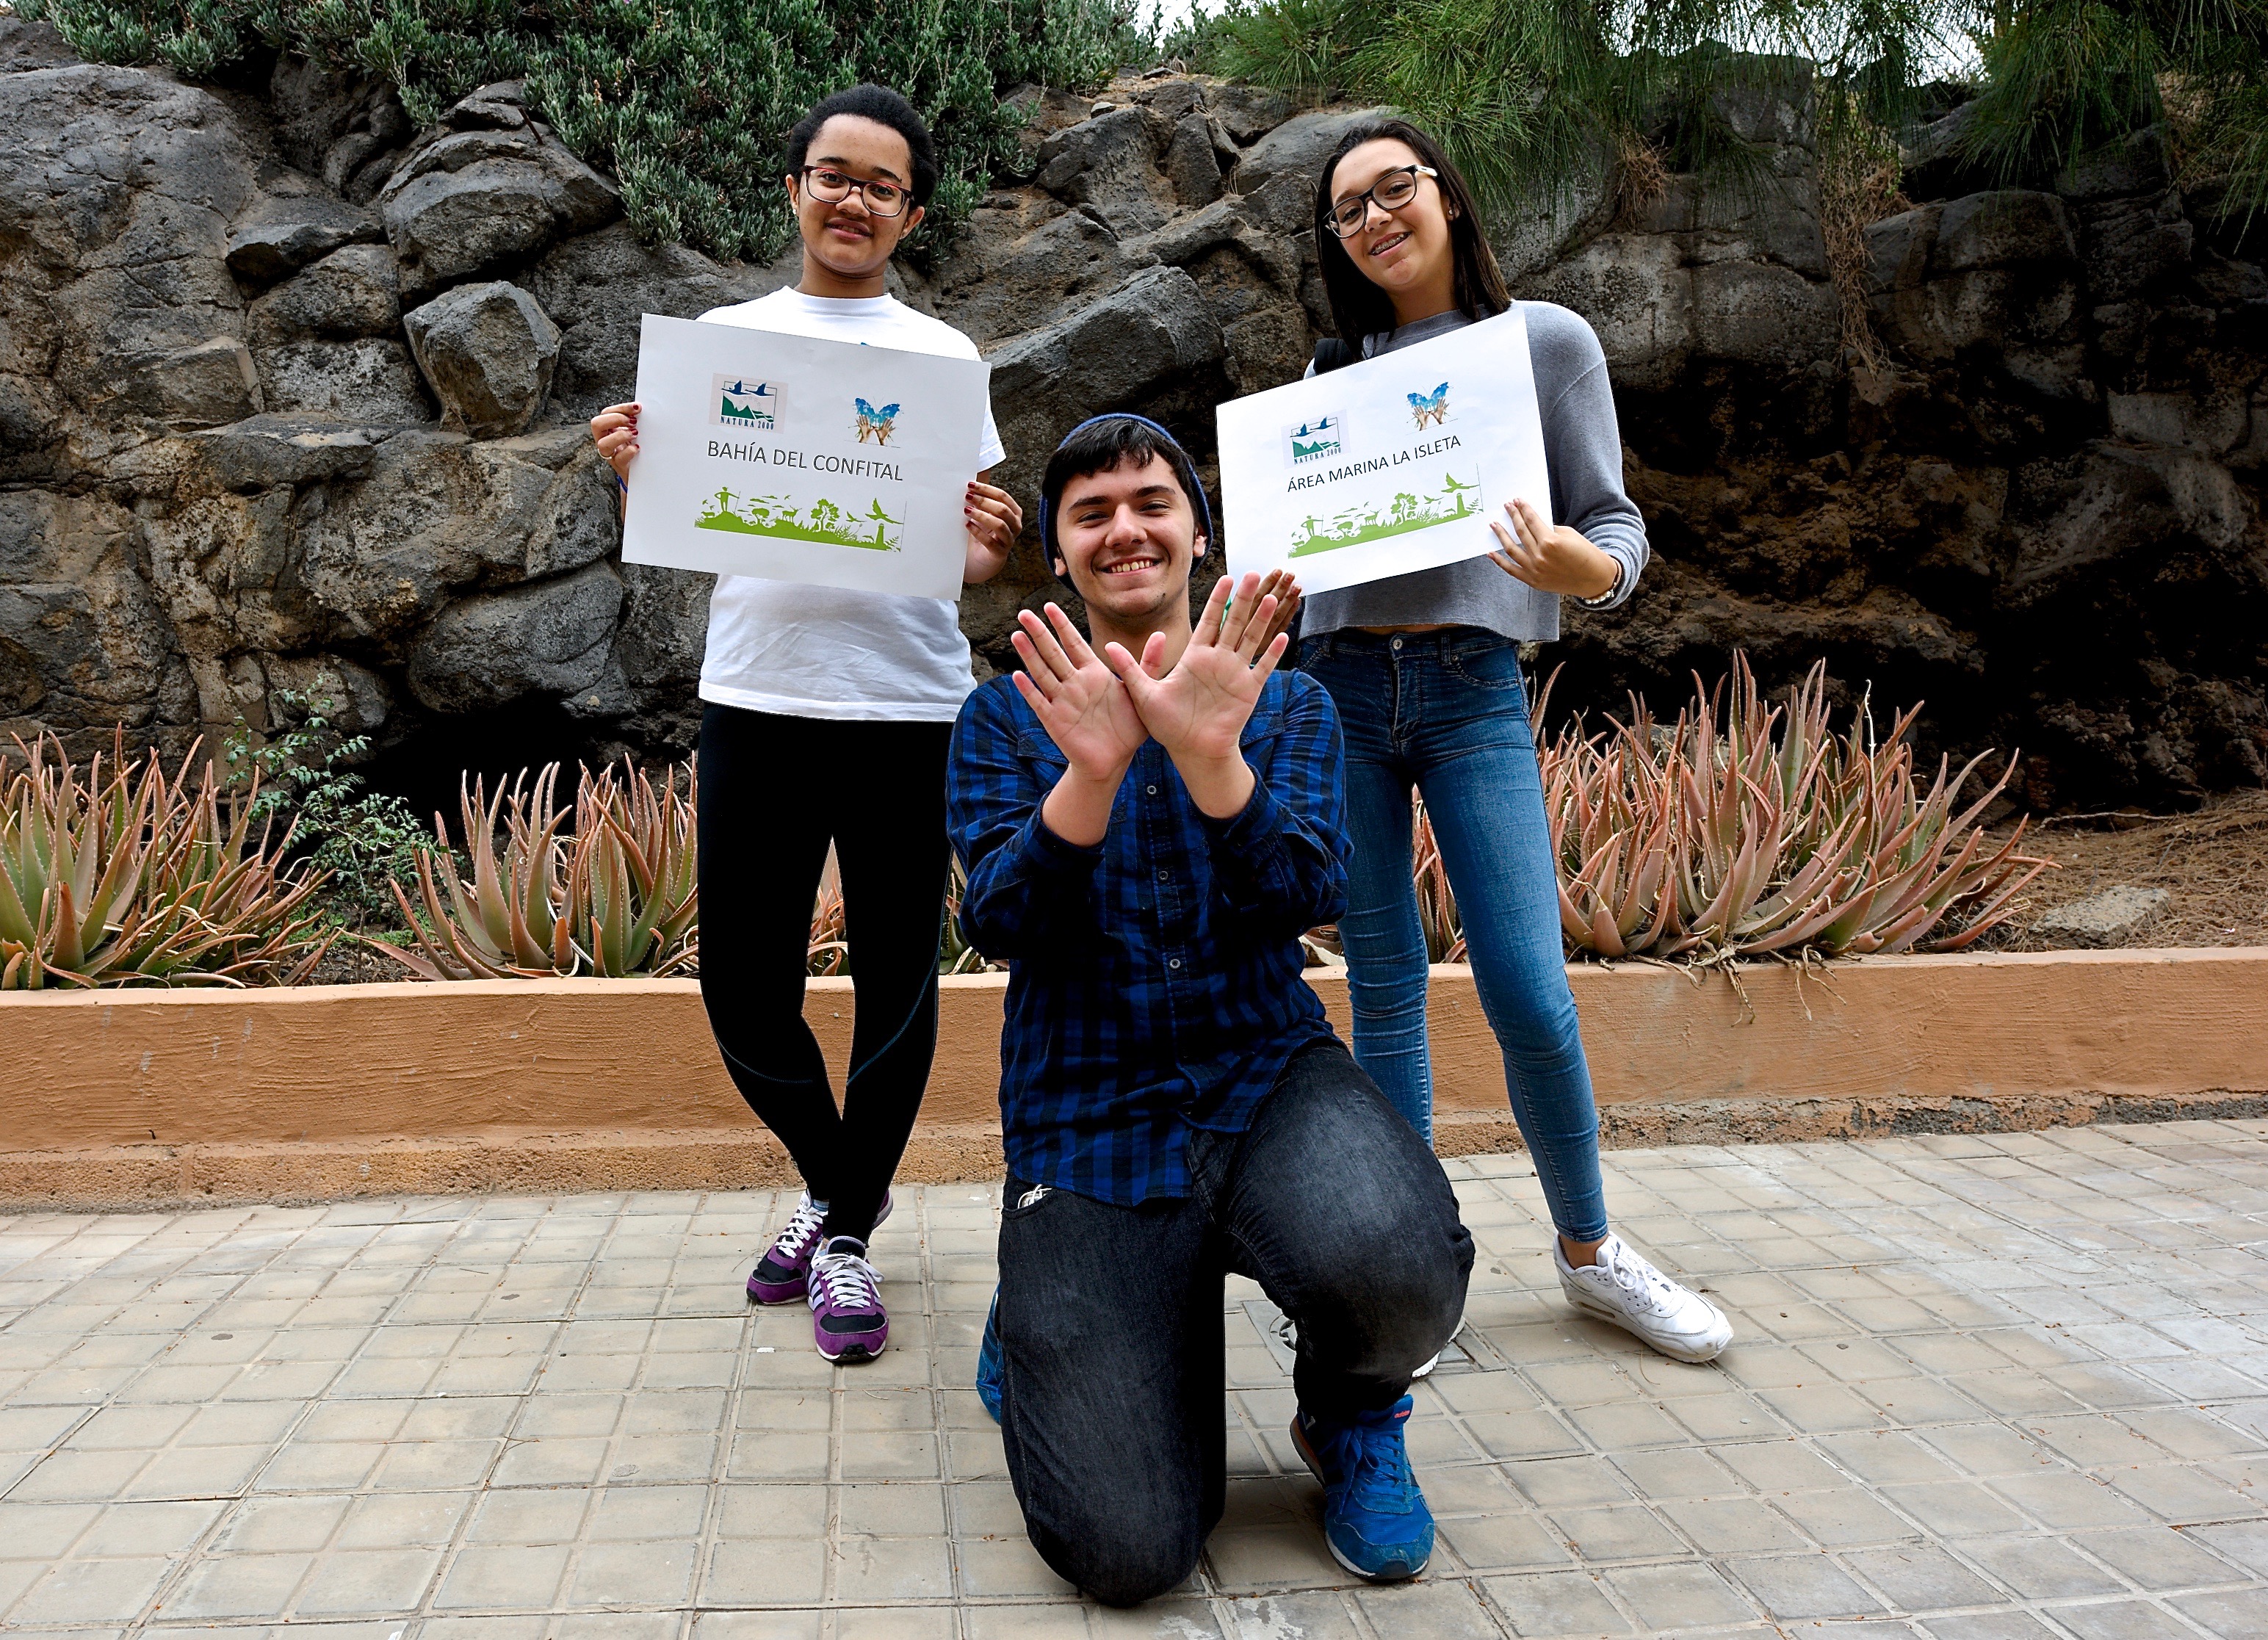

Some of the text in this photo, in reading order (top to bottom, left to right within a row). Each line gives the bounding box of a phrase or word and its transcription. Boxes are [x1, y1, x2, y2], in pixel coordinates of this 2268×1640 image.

[721, 416, 774, 430] NATURA 2000
[707, 441, 903, 482] BAHÍA DEL CONFITAL
[1288, 435, 1461, 493] ÁREA MARINA LA ISLETA
[1294, 447, 1341, 465] NATURA 2000
